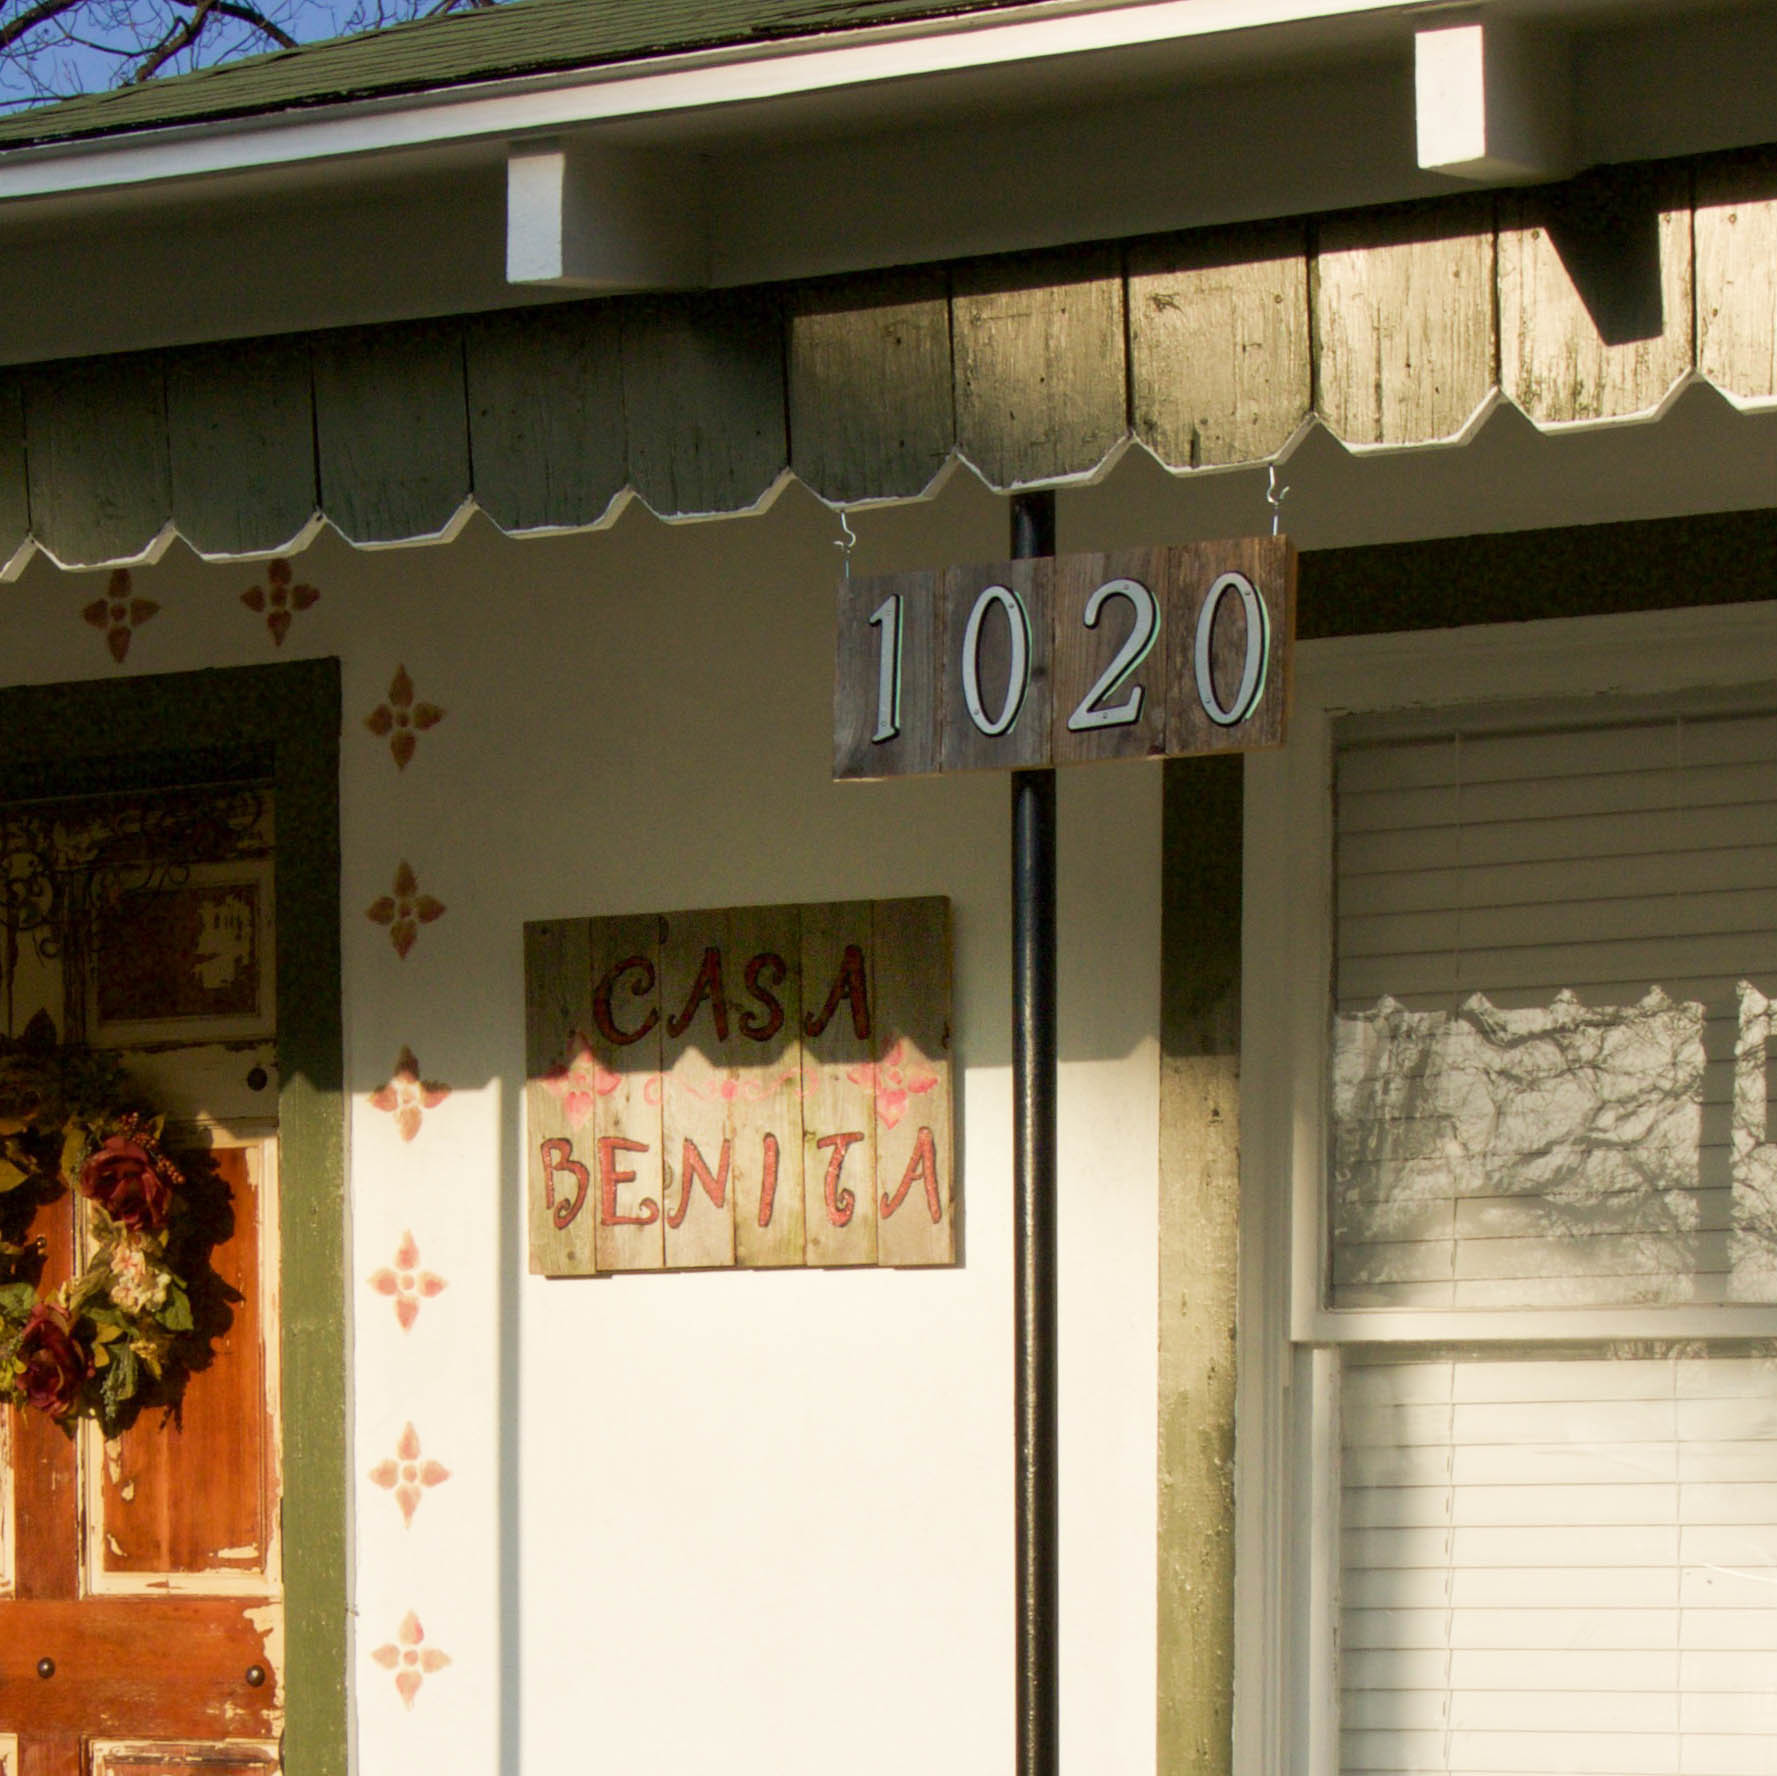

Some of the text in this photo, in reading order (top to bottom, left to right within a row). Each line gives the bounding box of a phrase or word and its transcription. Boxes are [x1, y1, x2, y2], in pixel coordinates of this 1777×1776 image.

[869, 571, 1270, 744] 1020
[592, 944, 872, 1045] CASA
[540, 1126, 943, 1231] BENITA
